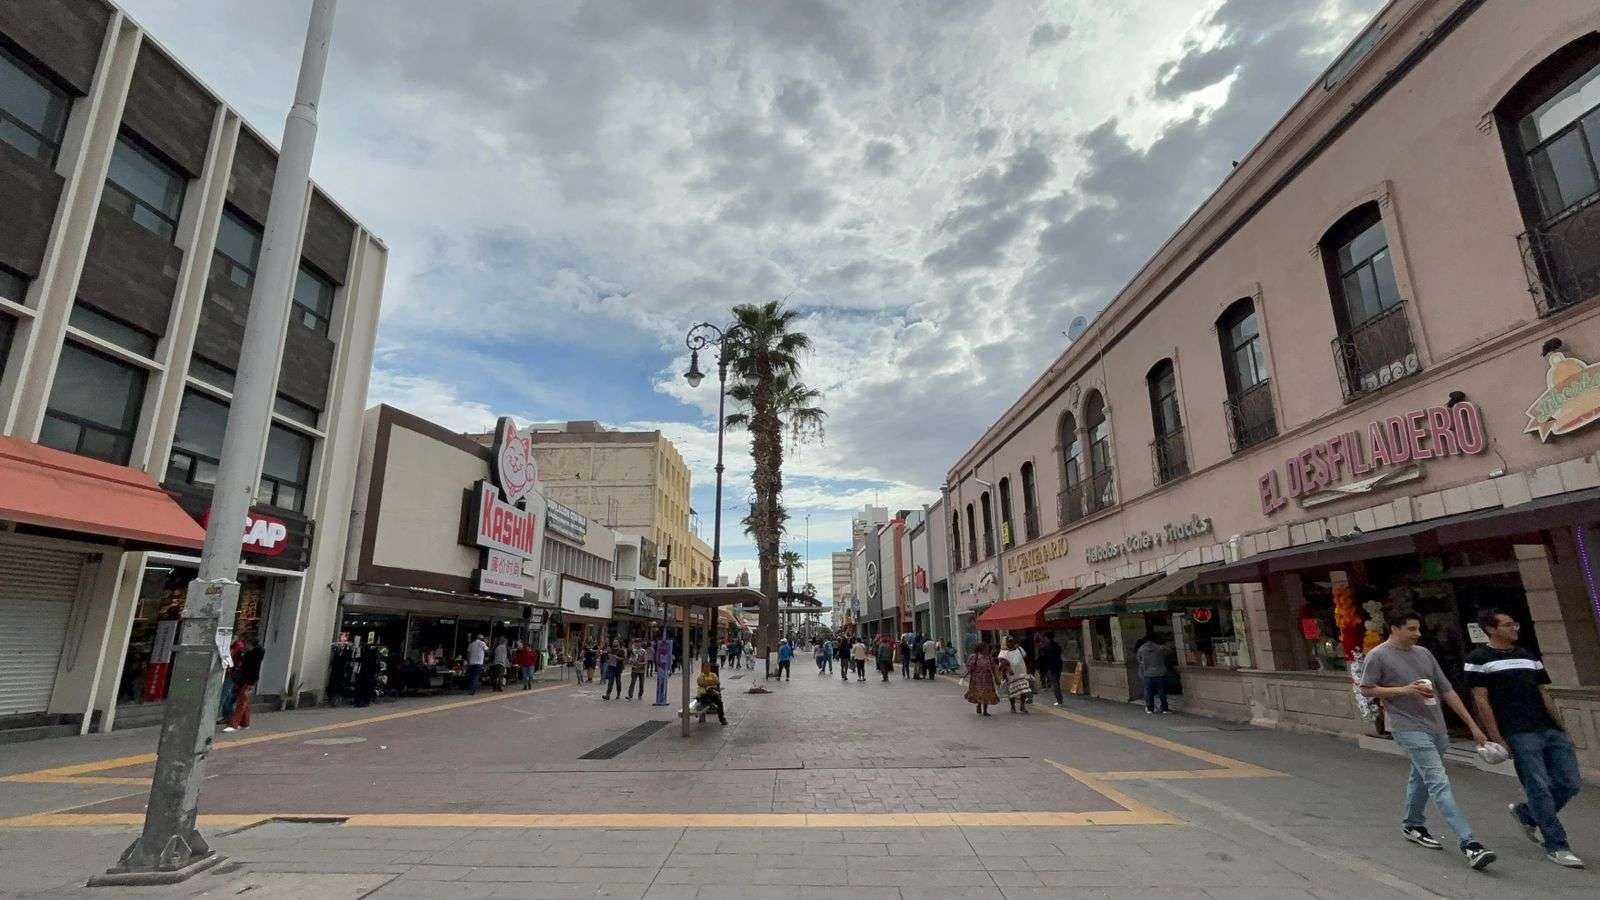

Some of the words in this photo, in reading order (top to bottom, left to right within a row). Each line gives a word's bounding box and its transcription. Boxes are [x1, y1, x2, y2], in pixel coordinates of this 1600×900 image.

[1258, 467, 1287, 516] EL
[1285, 401, 1485, 498] DESFILADERO
[482, 489, 536, 554] KASHIN
